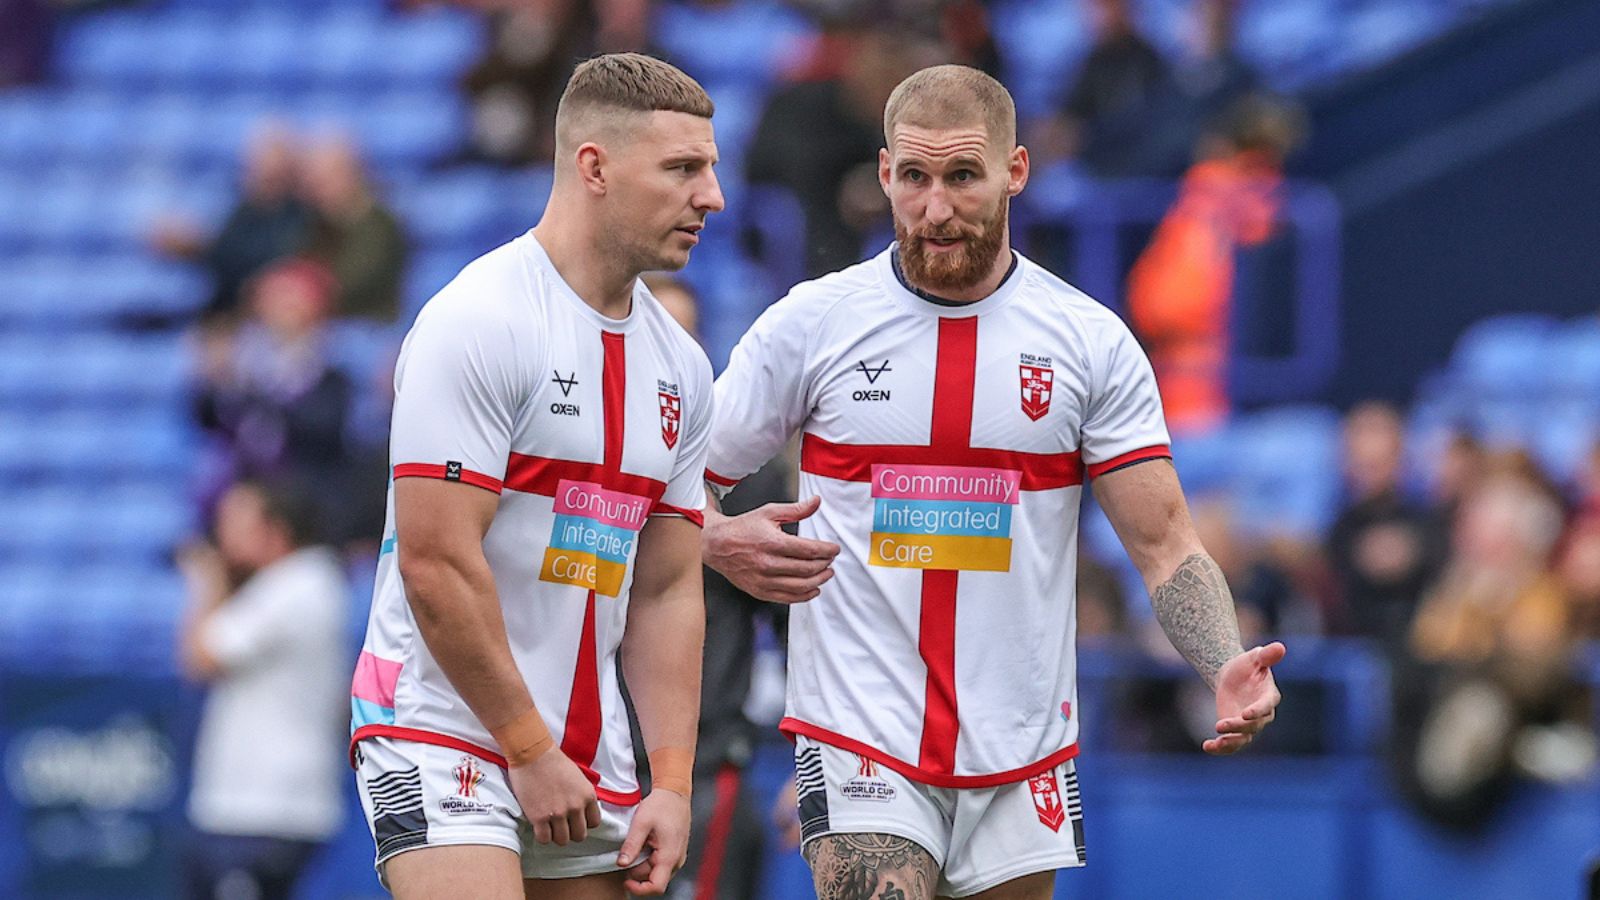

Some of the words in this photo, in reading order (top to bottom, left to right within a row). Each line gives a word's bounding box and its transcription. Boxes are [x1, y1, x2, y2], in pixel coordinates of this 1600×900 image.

[852, 390, 890, 401] OXEN
[550, 403, 580, 416] OXEN
[879, 468, 1015, 503] Community
[883, 503, 1001, 534] Integrated
[879, 539, 933, 563] Care
[552, 555, 597, 584] Care
[842, 786, 876, 794] WORLD
[877, 787, 894, 796] CUP
[442, 801, 474, 809] WORLD
